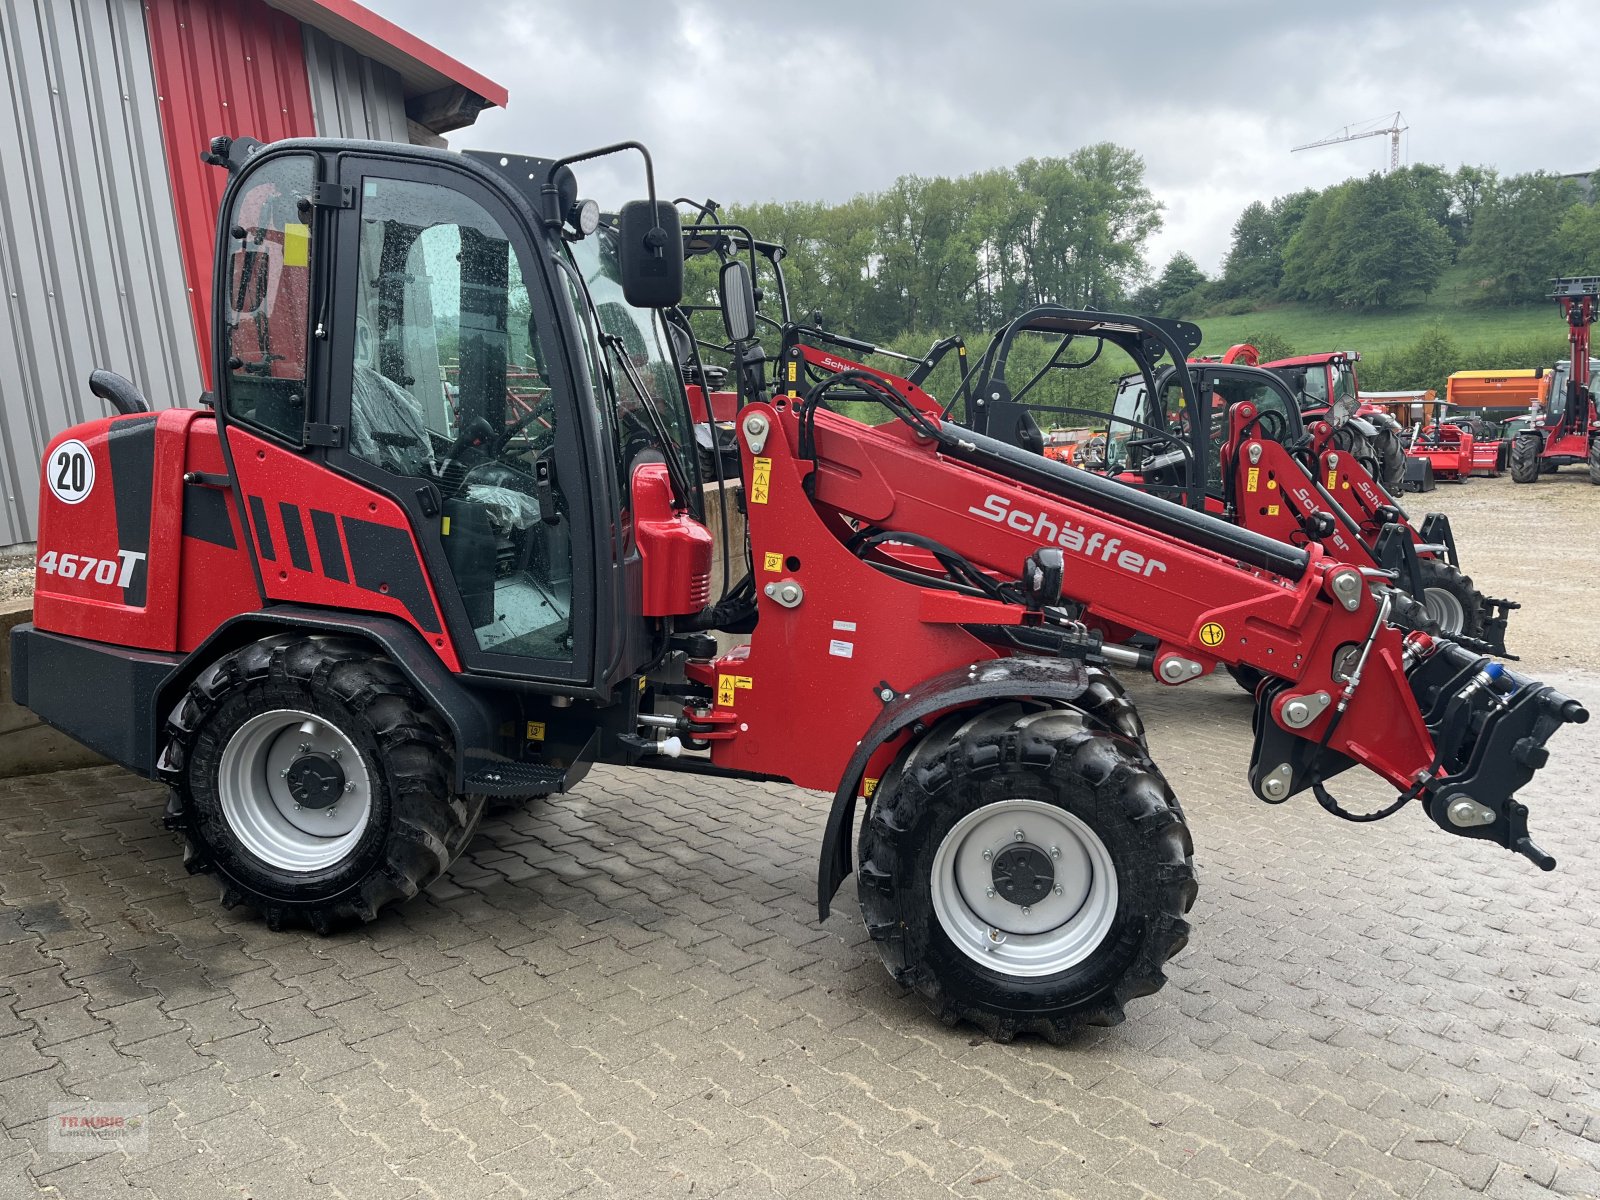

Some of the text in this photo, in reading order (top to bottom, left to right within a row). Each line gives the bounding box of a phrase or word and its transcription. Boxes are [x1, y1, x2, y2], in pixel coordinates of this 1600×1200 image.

[57, 451, 85, 492] 20
[968, 493, 1167, 577] Schäffer
[38, 549, 146, 588] 4670T
